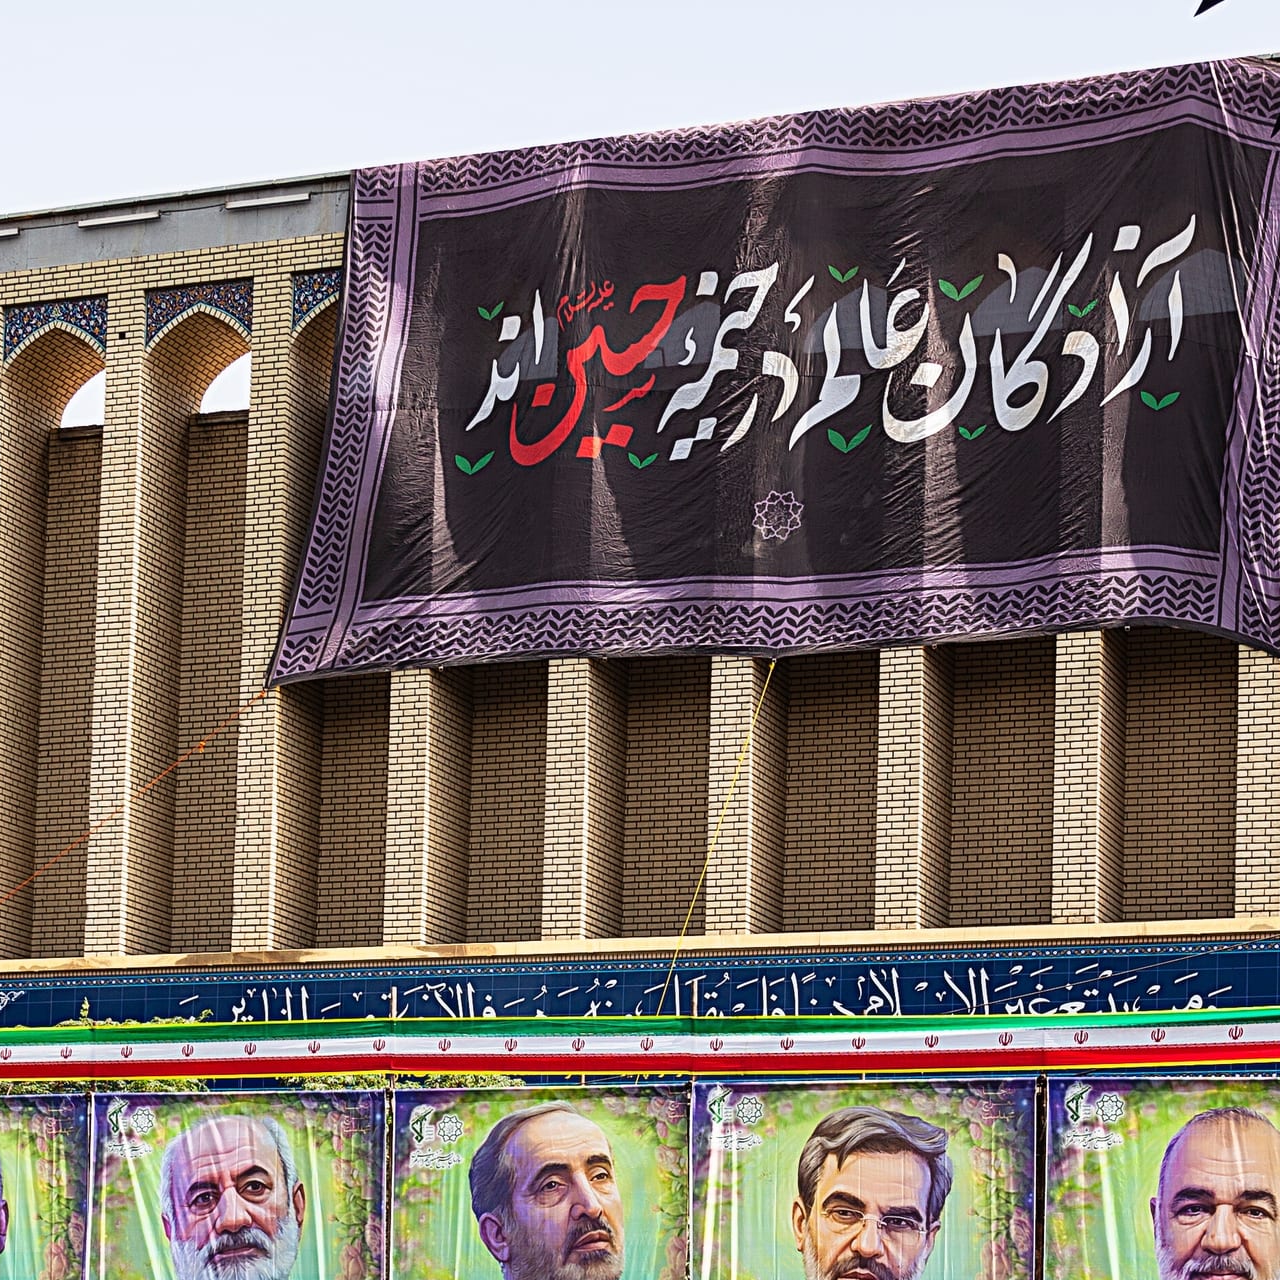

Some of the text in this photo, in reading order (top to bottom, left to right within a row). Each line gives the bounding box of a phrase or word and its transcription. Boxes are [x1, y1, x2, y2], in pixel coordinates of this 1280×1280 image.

[509, 274, 687, 467] حسین
[719, 350, 800, 452] در
[882, 213, 1196, 443] آزادگان
